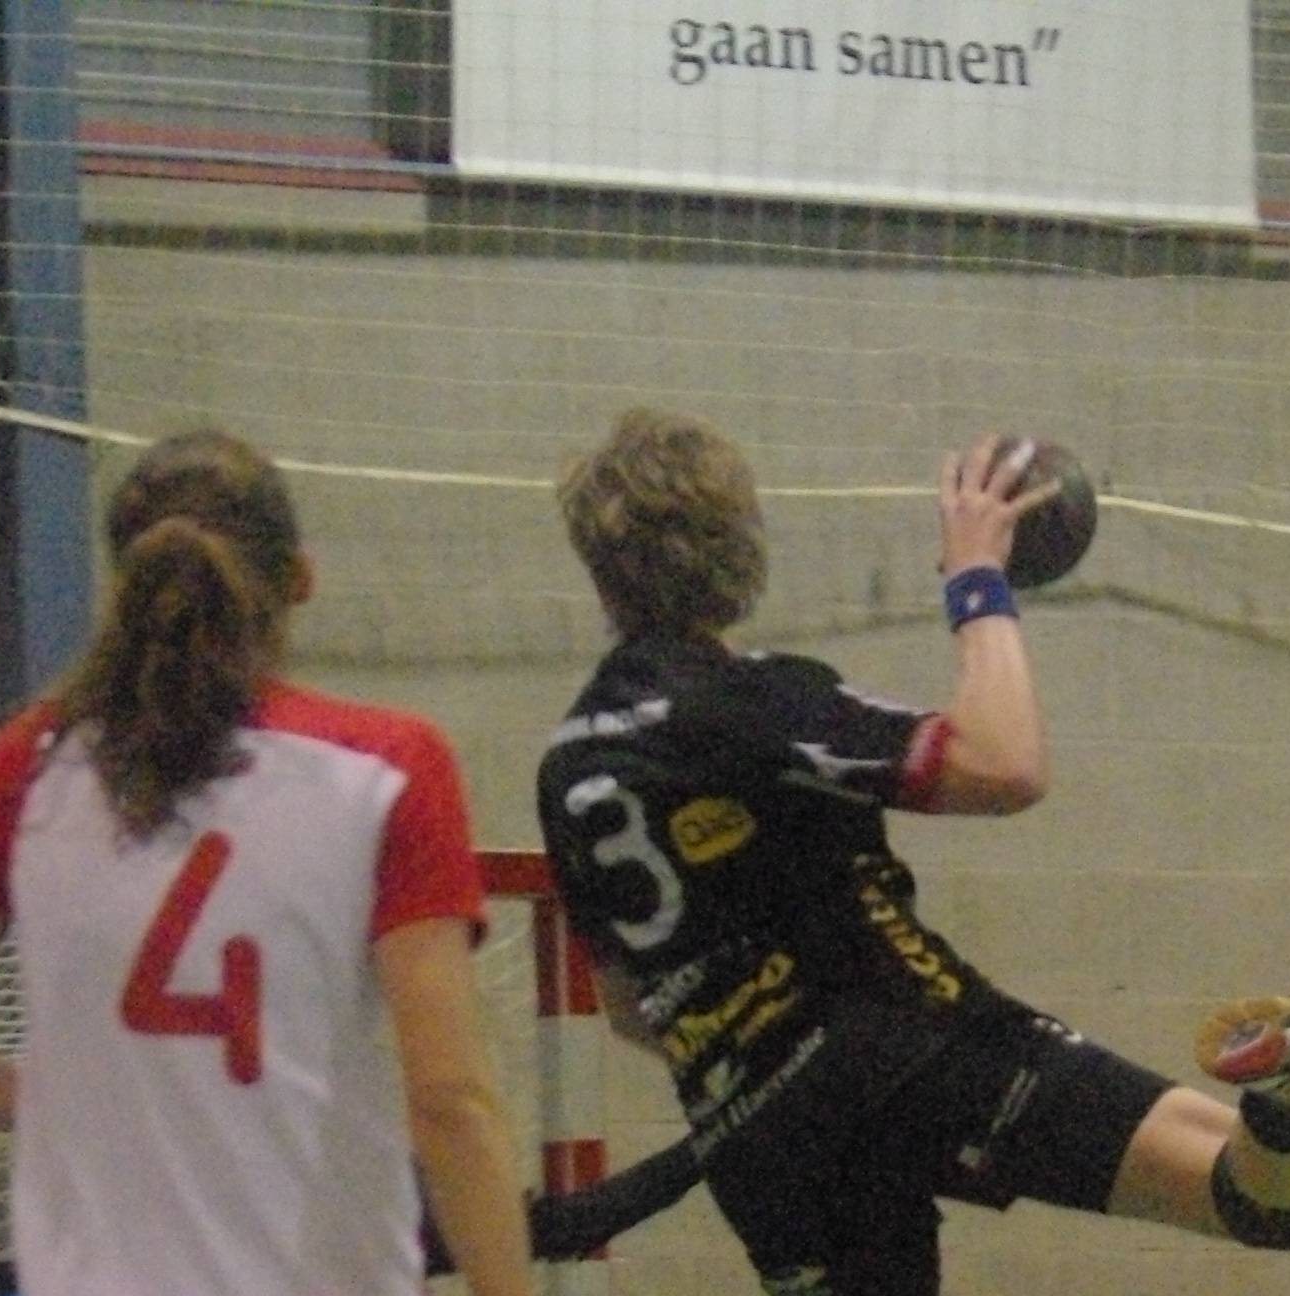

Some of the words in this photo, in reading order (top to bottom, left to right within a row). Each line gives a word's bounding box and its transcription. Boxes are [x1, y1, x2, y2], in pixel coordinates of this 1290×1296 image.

[669, 18, 818, 86] gaan
[565, 774, 685, 951] 3
[122, 830, 262, 1086] 4
